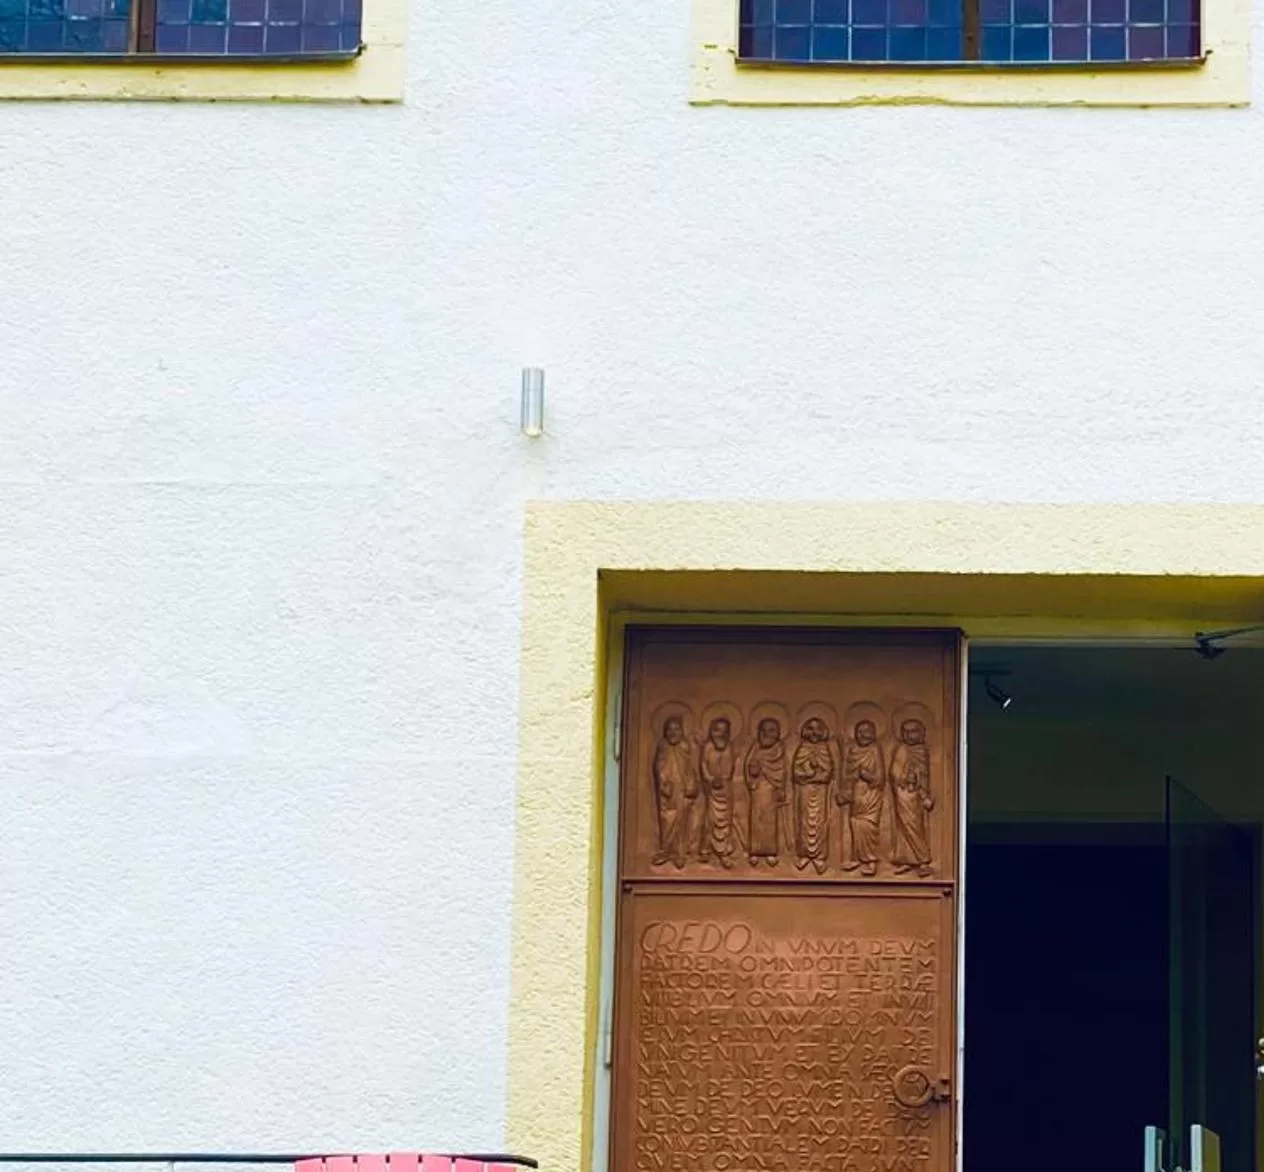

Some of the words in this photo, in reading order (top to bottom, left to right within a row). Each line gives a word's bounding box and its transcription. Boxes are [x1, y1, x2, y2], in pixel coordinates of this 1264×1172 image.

[640, 921, 753, 954] CREDO
[755, 938, 774, 953] IN
[787, 938, 858, 954] VNVM
[870, 939, 936, 956] DEVM
[640, 954, 729, 971] PATREM
[739, 955, 935, 974] OMNIPOTENTEM
[640, 972, 753, 989] FACTOREM
[819, 974, 846, 990] ET
[848, 990, 873, 1008] ET
[708, 1007, 733, 1025] ET
[795, 1043, 820, 1062] ET
[827, 1044, 856, 1063] EX
[708, 1079, 735, 1097] DE
[740, 1079, 784, 1098] DEO
[850, 1098, 876, 1117] DE
[637, 1114, 699, 1133] VERO
[808, 1116, 854, 1136] NON
